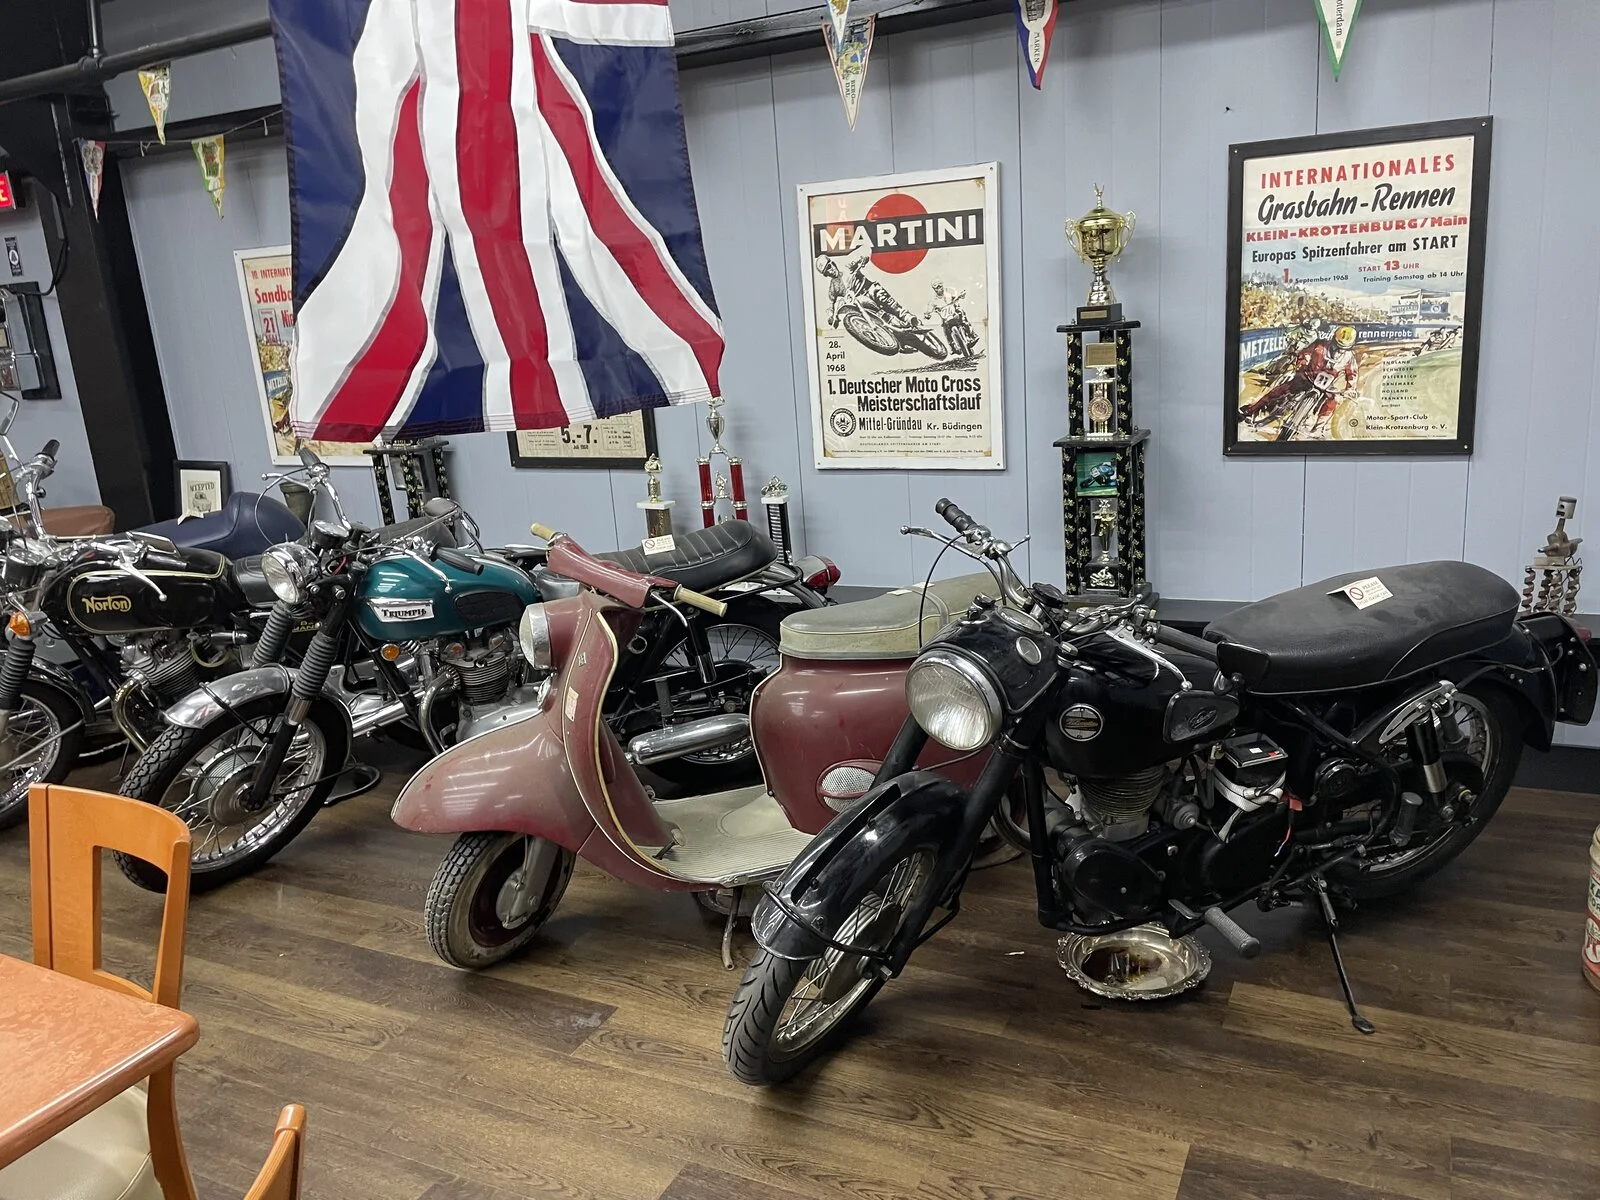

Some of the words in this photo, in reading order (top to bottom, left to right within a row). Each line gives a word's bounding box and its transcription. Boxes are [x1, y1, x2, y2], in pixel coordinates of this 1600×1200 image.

[1261, 154, 1455, 189] INTERNATIONALES
[819, 215, 977, 252] MARTINI
[1252, 250, 1296, 264] Europas
[1302, 241, 1382, 262] Spitzenfahrer
[1388, 242, 1407, 252] am
[1413, 235, 1458, 251] START
[1358, 265, 1381, 273] START
[1384, 260, 1400, 271] 13
[1402, 262, 1420, 270] UHR
[1295, 276, 1331, 284] September
[263, 317, 275, 333] 21
[1359, 329, 1413, 339] rennerprobt
[828, 341, 841, 349] 28.
[826, 352, 845, 361] April
[827, 364, 846, 372] 1968
[828, 379, 836, 395] 1.
[839, 377, 902, 395] Deutscher
[905, 376, 938, 394] Moto
[942, 375, 981, 392] Cross
[857, 394, 982, 412] Meisterschaftslauf
[858, 416, 922, 431] Mittel-Gründau
[927, 422, 939, 430] Kr.
[942, 422, 983, 432] Büdingen
[82, 595, 131, 613] Norton
[381, 608, 427, 618] TRIUMPH
